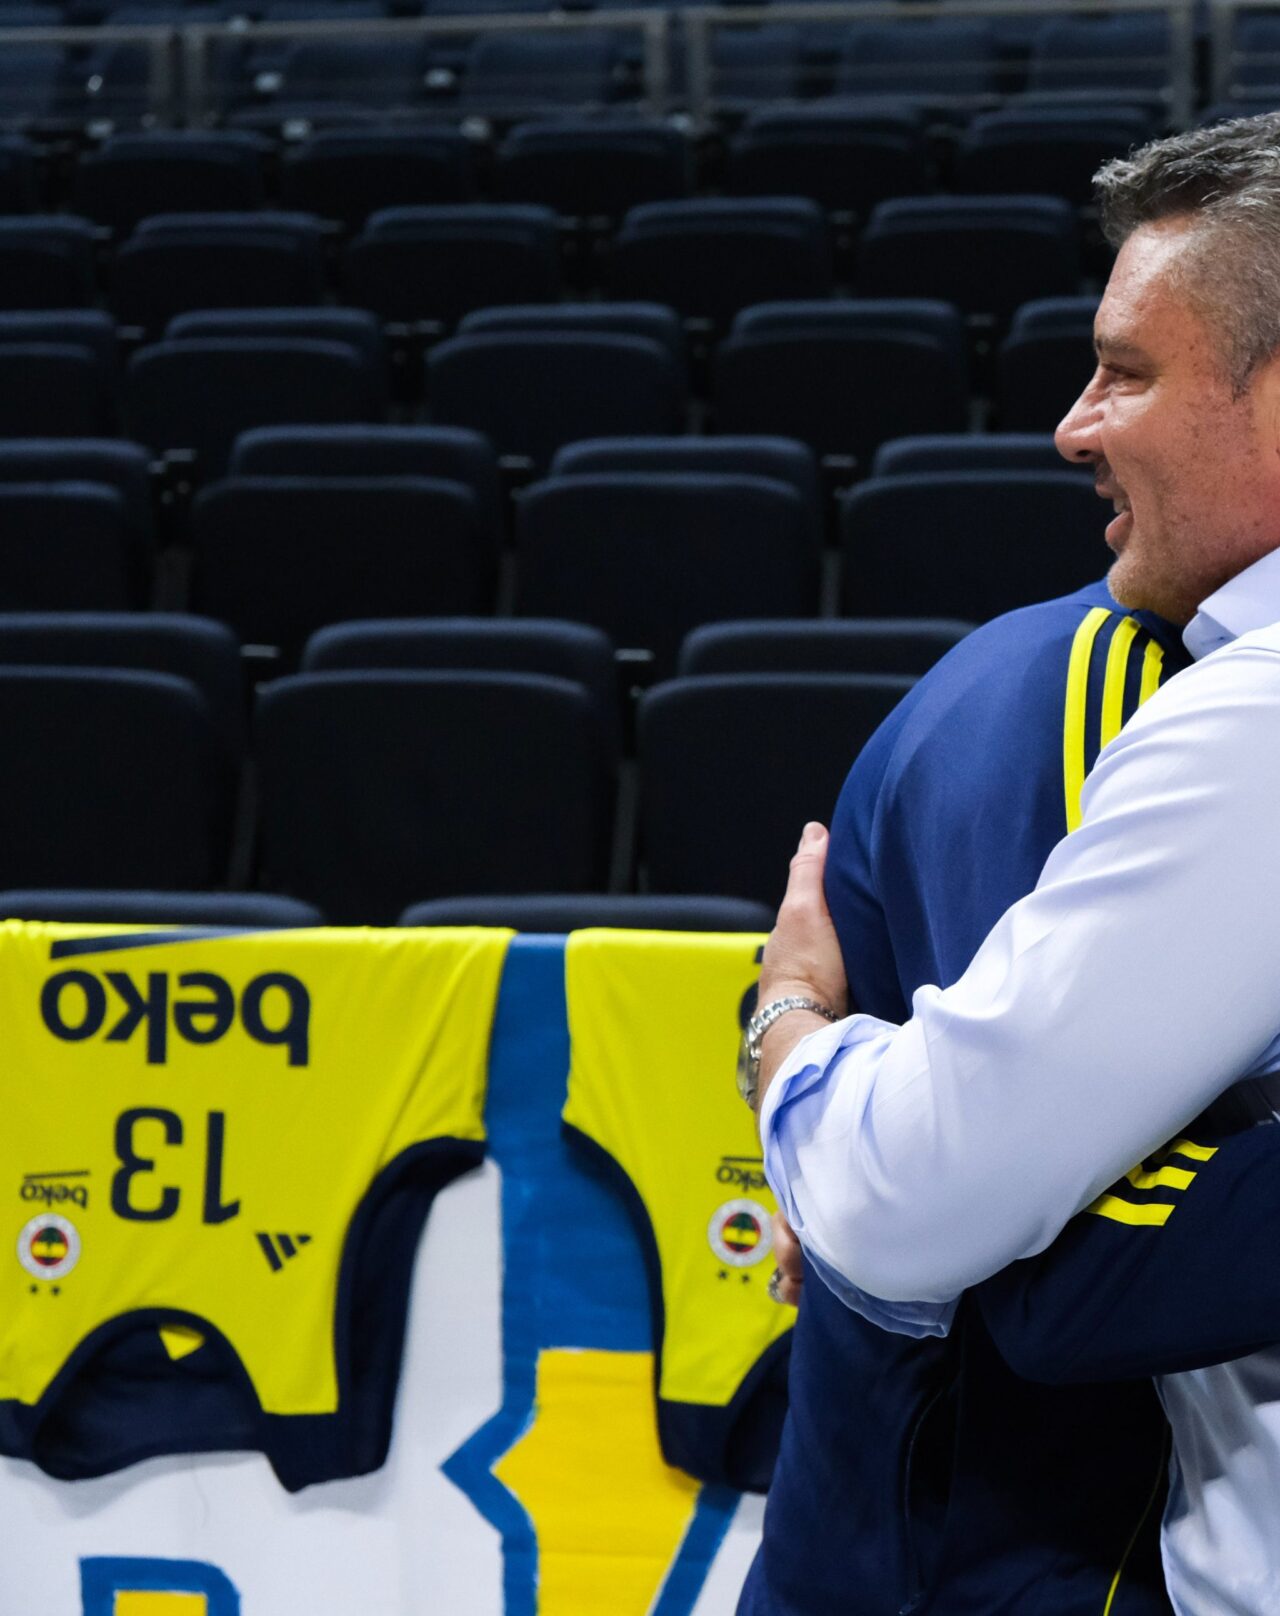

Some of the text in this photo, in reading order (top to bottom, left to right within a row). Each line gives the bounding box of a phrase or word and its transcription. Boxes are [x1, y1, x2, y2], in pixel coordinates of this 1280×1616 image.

[40, 969, 311, 1067] beko
[20, 1181, 89, 1209] beko
[110, 1107, 240, 1225] 13
